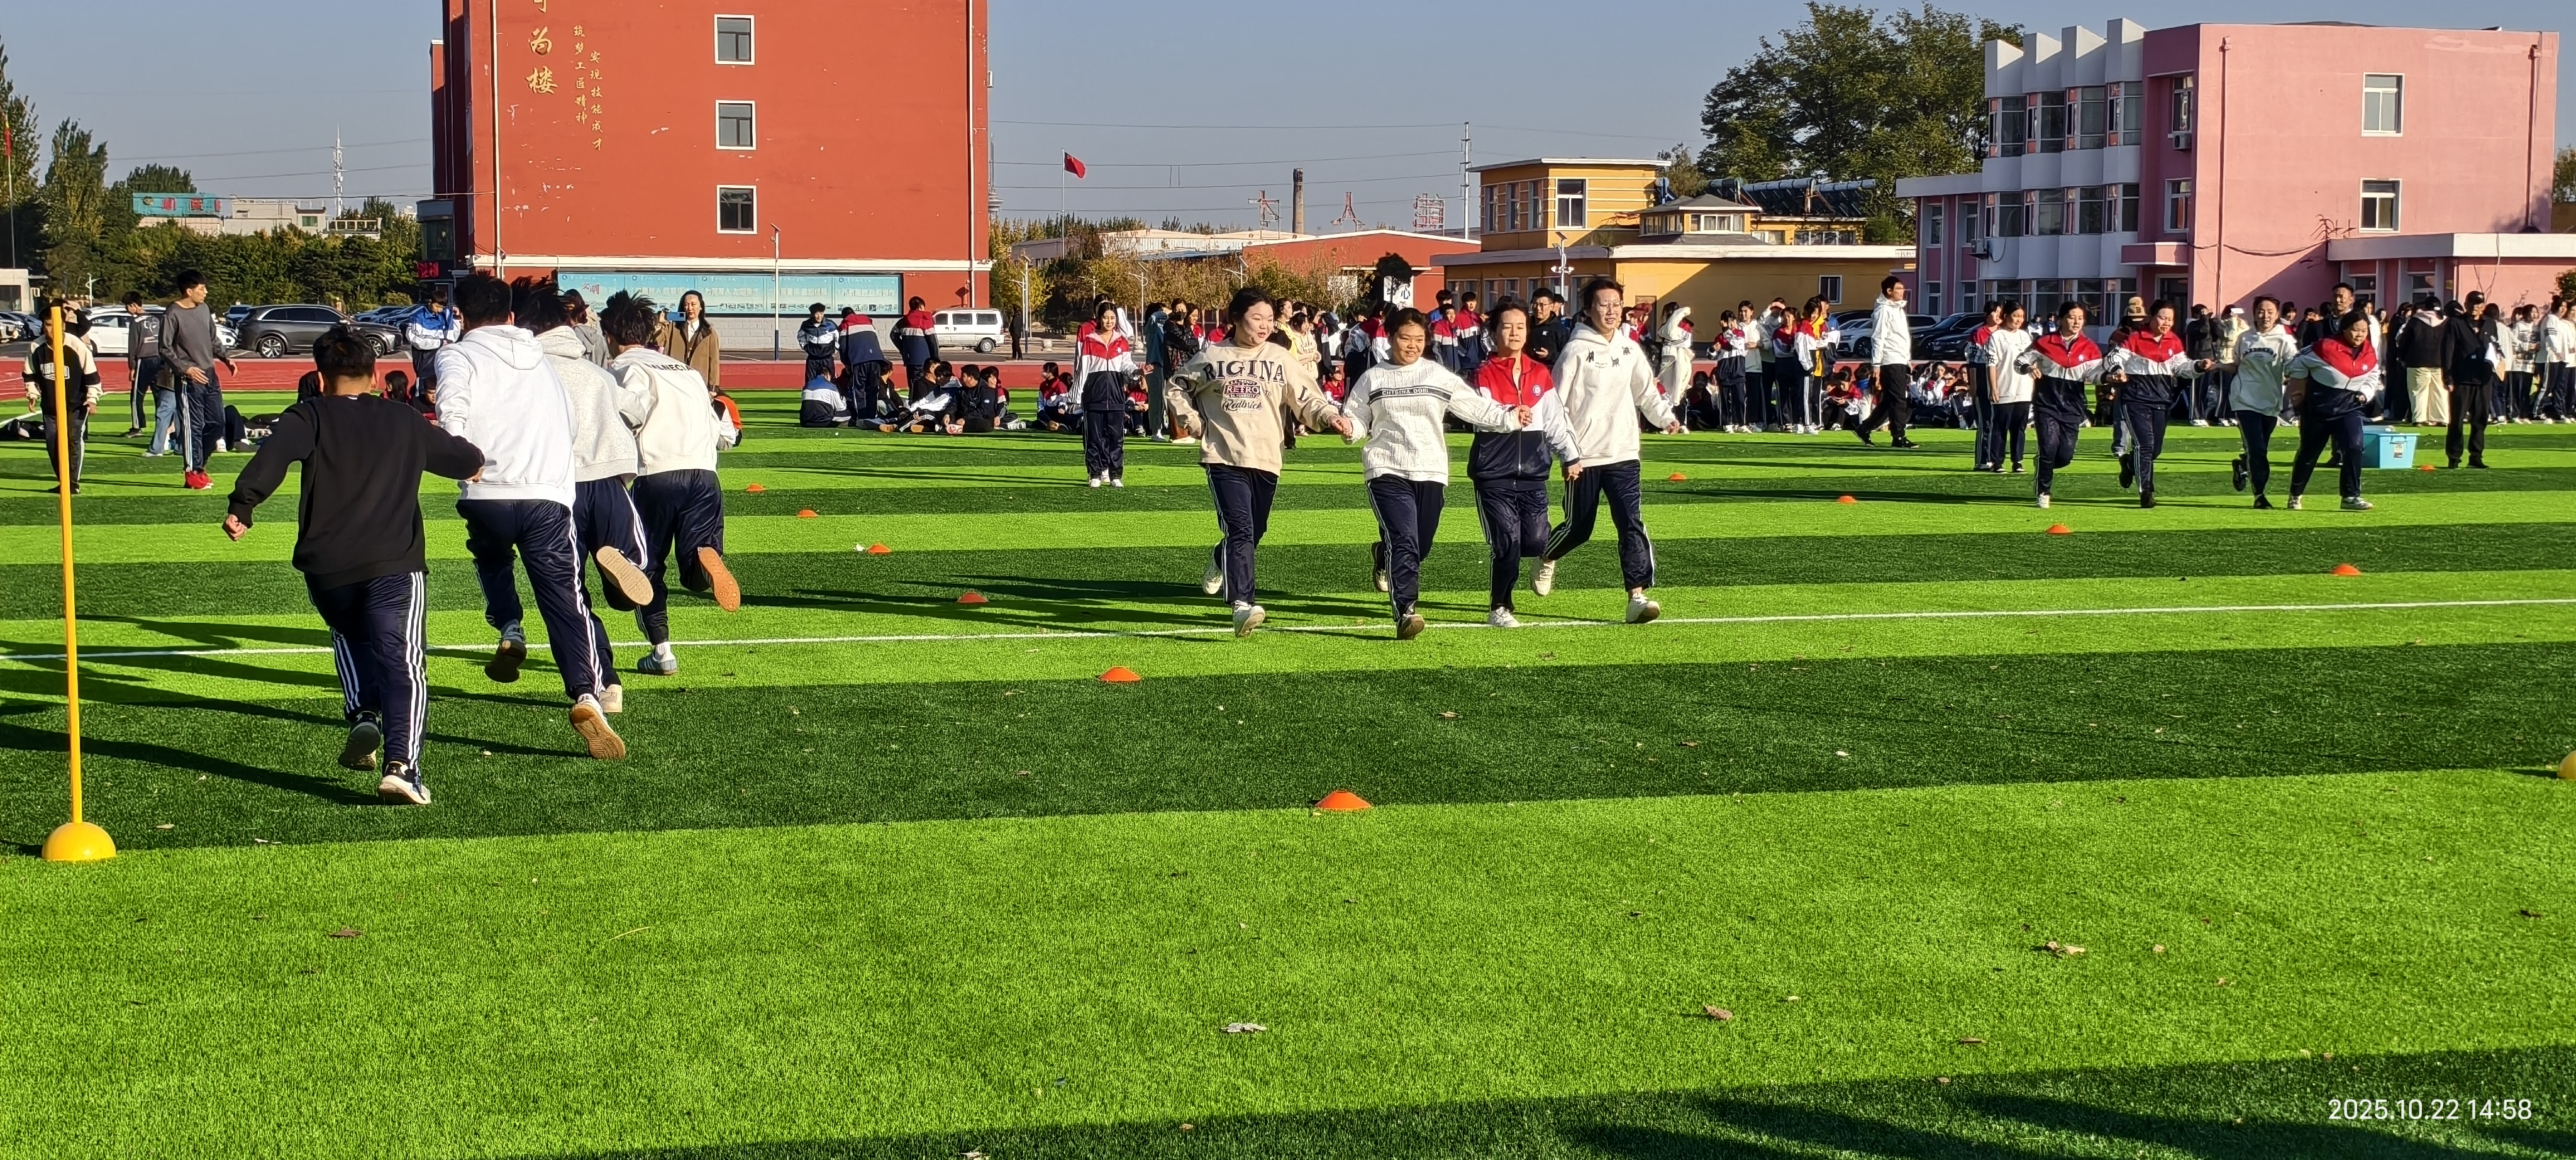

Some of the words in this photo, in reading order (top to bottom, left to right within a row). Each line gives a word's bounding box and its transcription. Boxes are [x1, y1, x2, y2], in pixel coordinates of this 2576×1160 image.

[589, 51, 603, 151] 实现技能成才
[1226, 385, 1260, 394] RETRO
